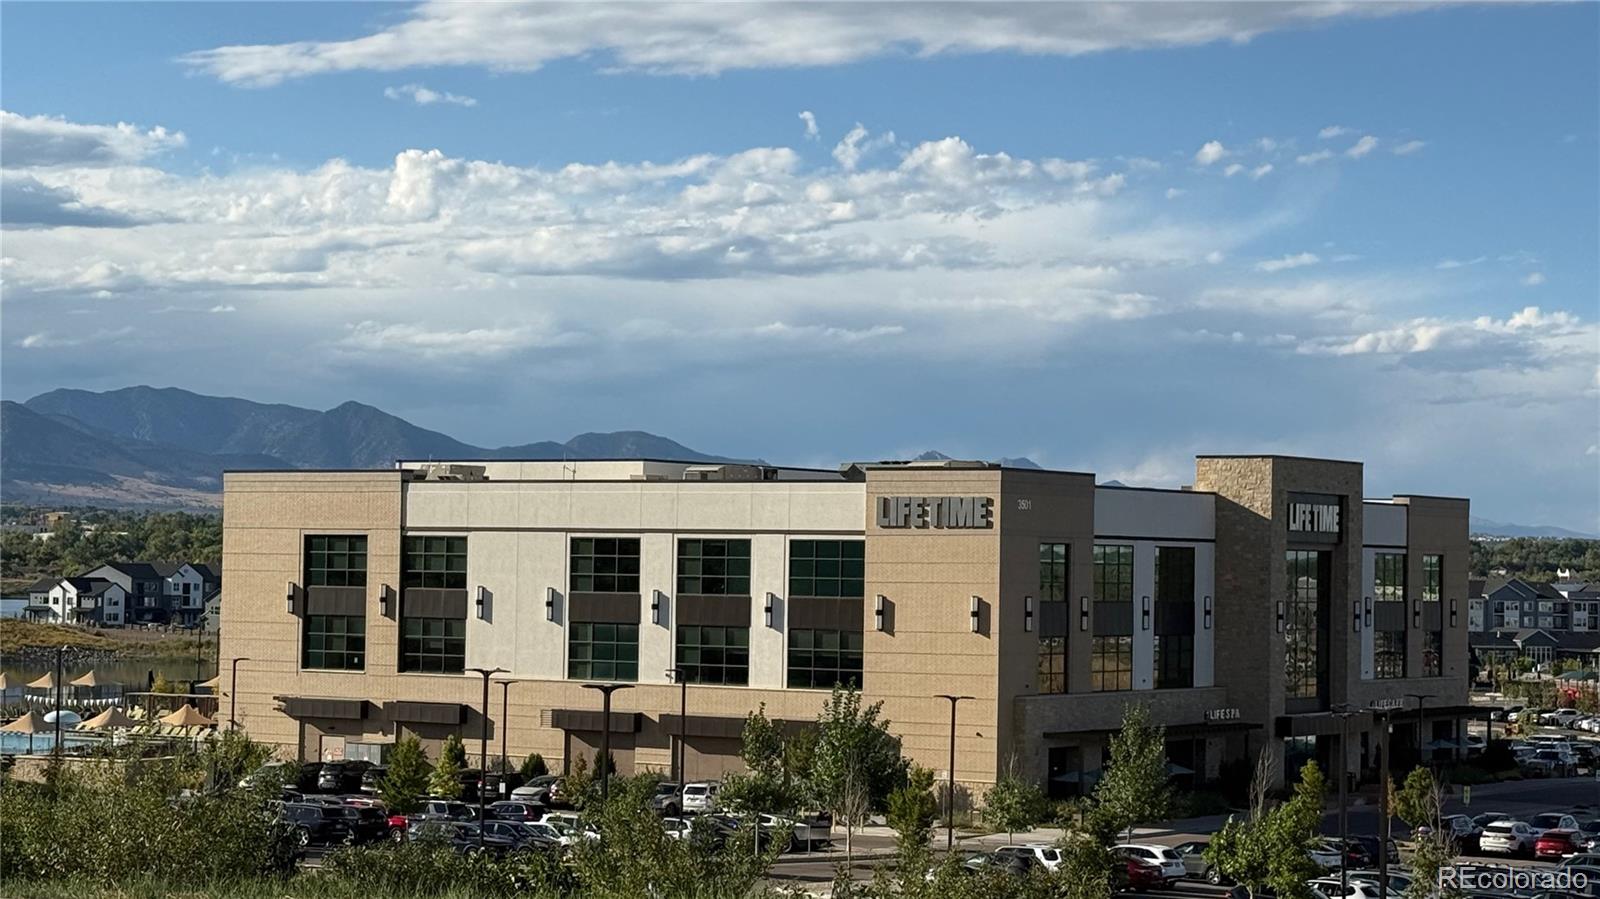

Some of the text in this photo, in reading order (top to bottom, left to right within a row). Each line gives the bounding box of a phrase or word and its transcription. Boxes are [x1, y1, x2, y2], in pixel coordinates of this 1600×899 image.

[1016, 499, 1032, 510] 3501
[1289, 503, 1340, 532] LIFE TIME
